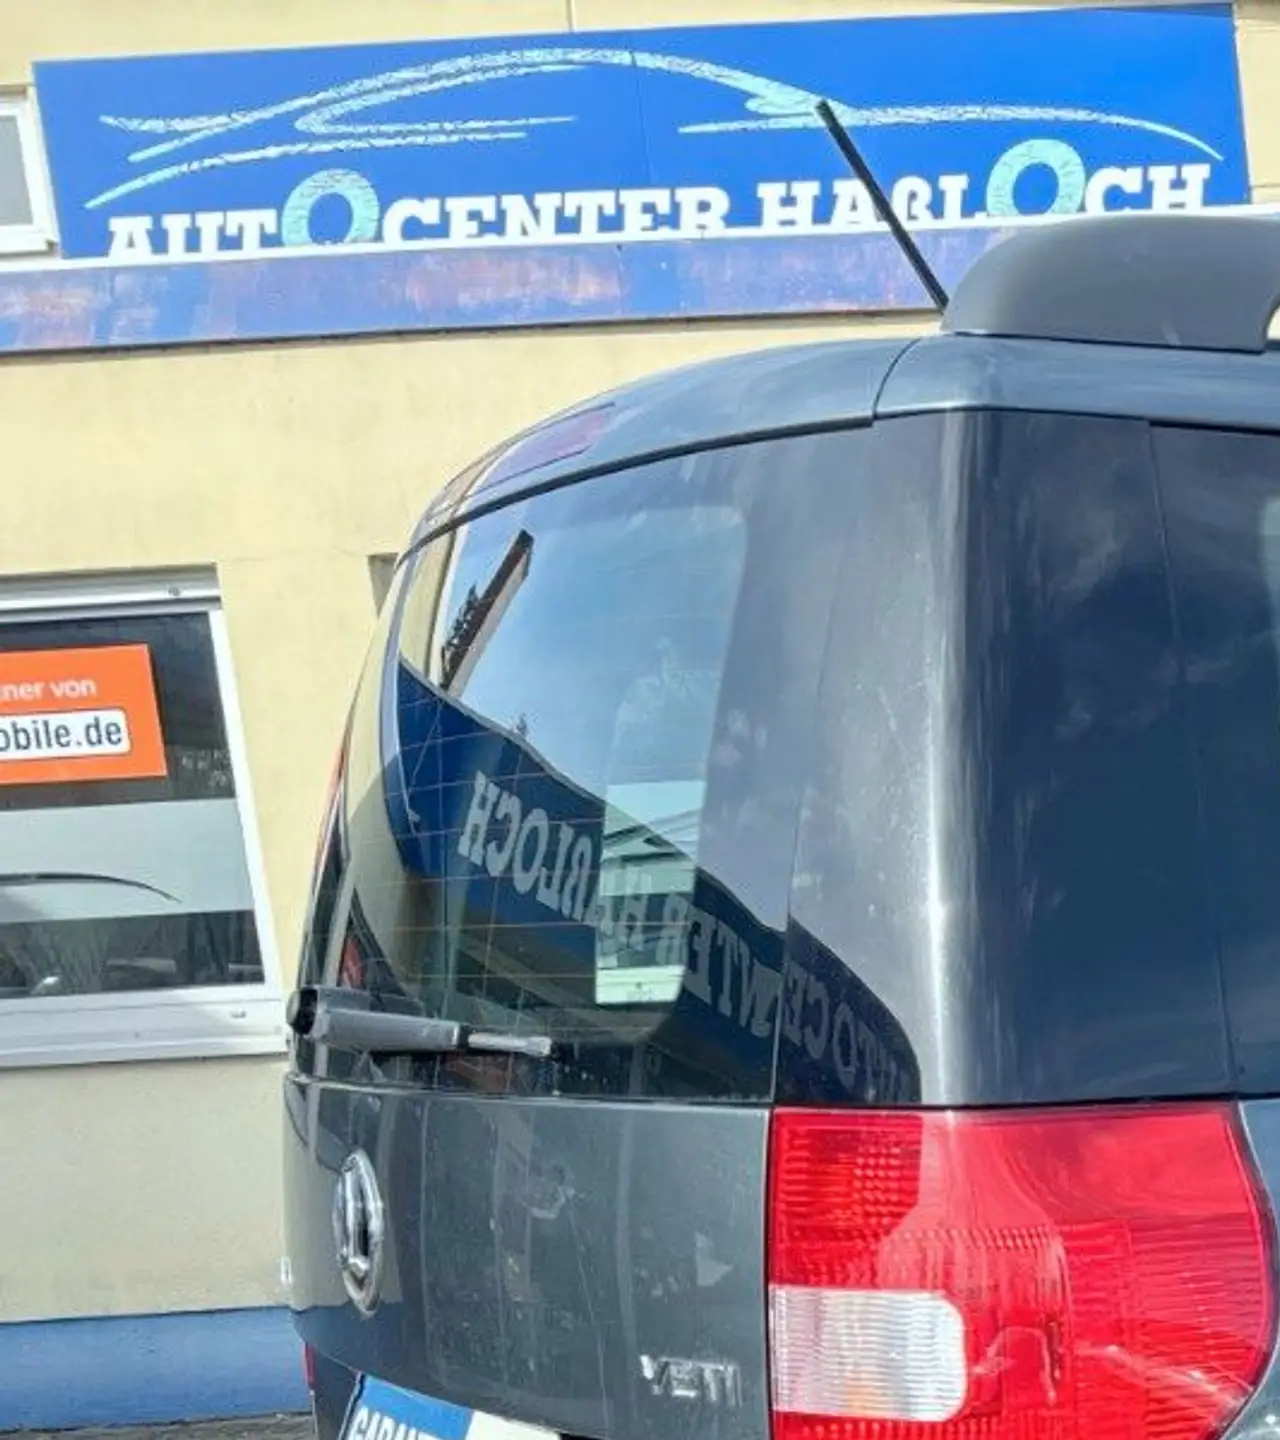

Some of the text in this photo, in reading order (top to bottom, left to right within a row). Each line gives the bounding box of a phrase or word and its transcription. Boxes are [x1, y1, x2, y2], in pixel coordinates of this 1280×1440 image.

[107, 167, 731, 258] AUTOCENTER
[0, 678, 97, 701] ner von
[640, 1354, 743, 1408] YETI
